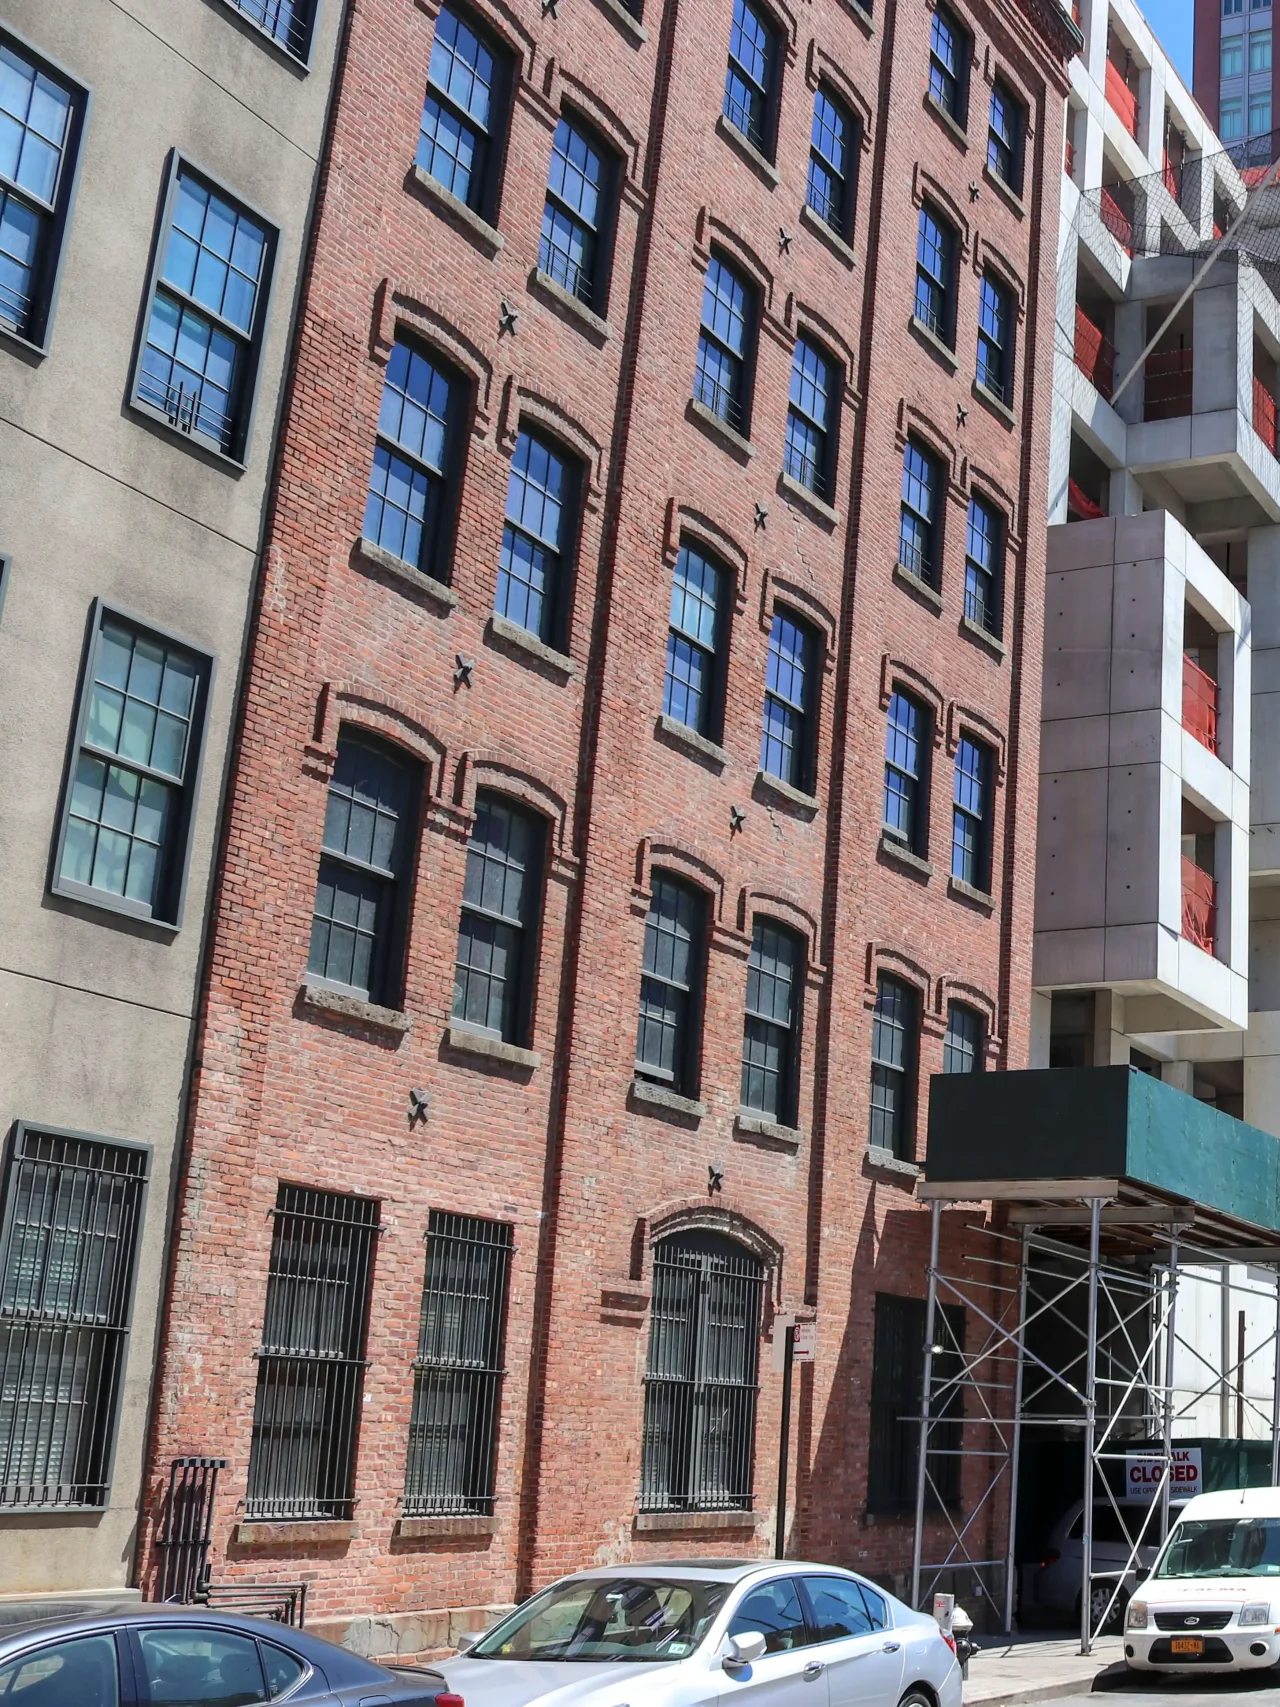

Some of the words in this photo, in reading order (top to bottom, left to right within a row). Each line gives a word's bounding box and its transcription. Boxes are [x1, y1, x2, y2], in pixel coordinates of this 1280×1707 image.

[1137, 1452, 1190, 1463] SIDEALK
[1129, 1464, 1198, 1483] CLOSED
[1130, 1487, 1141, 1495] USE
[1170, 1485, 1198, 1493] SIDEWALK
